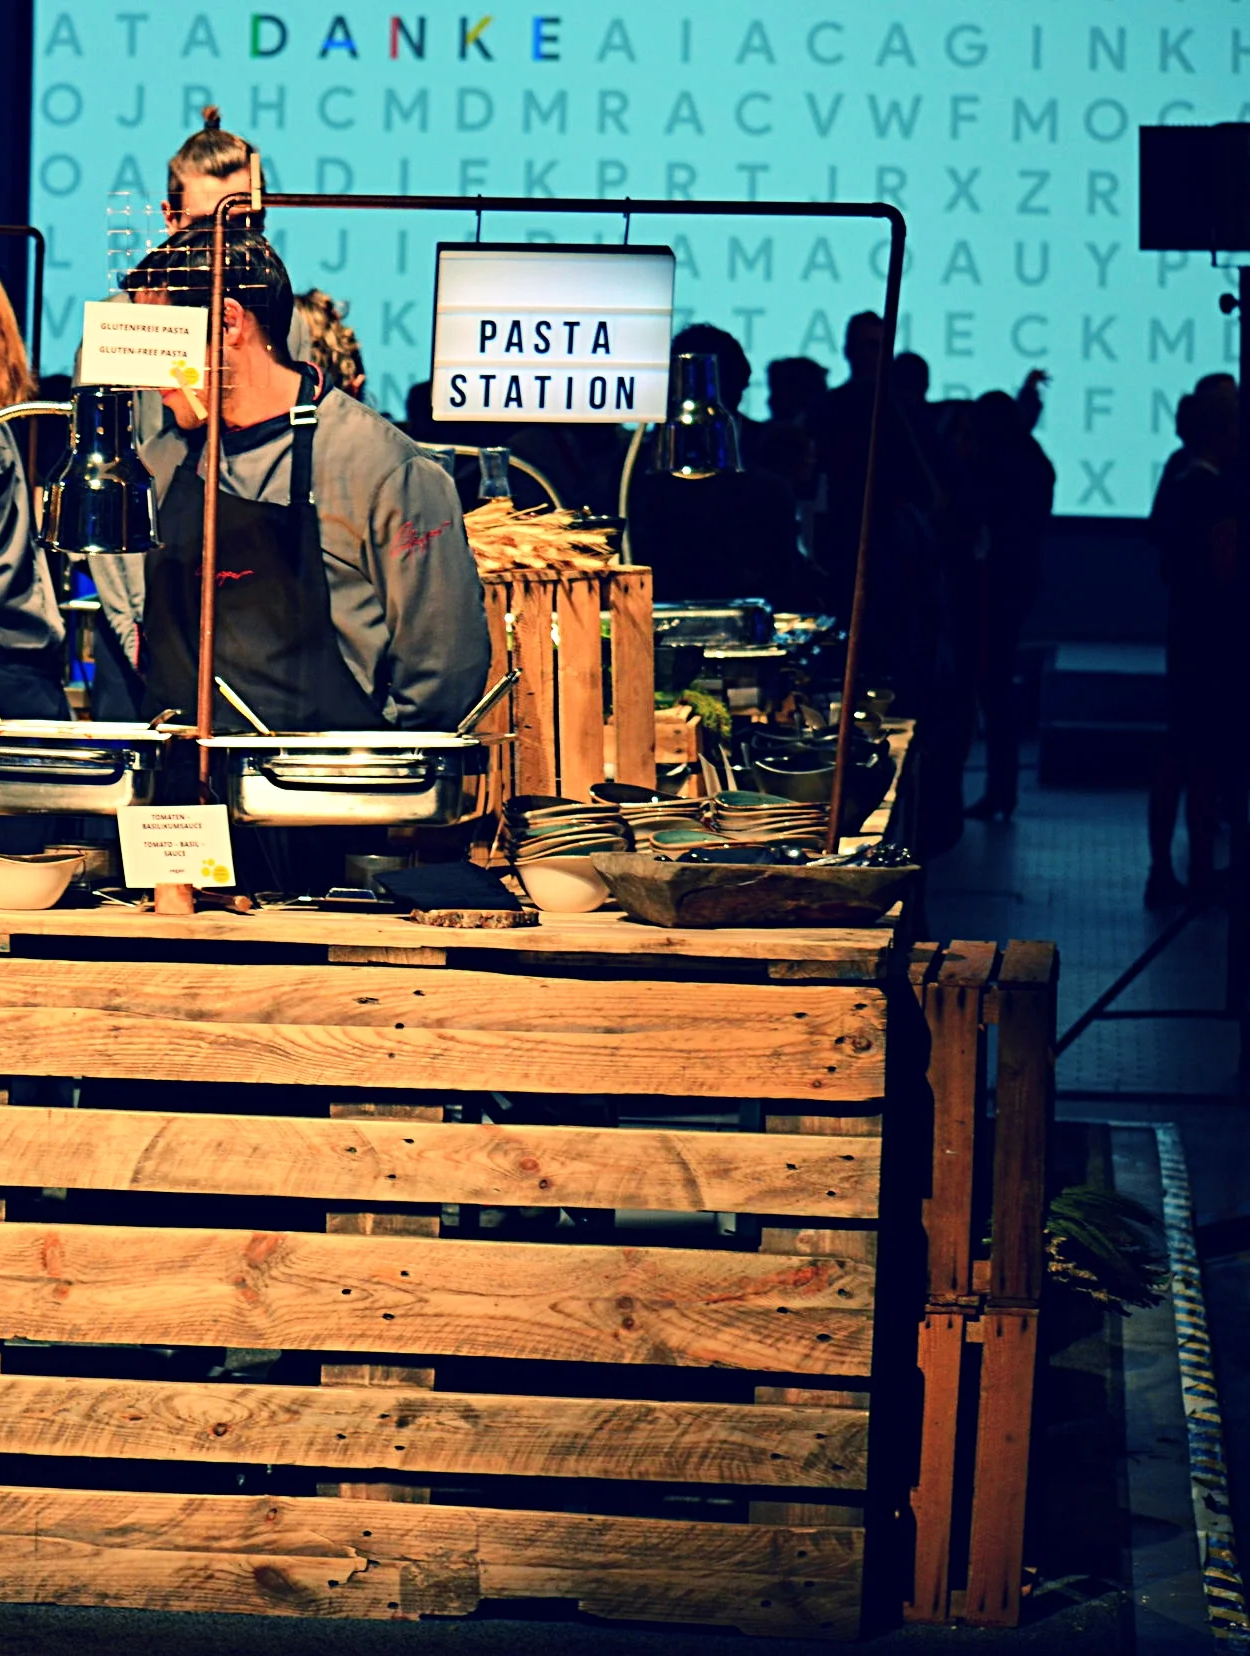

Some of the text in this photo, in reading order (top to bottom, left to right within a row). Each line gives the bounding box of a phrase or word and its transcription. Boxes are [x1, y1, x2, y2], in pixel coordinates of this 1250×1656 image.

[250, 14, 563, 62] DANKE
[100, 322, 190, 335] GLUTENFREIE PASTA
[479, 319, 611, 355] PASTA
[99, 346, 188, 358] GLUTEN-FREE PASTA
[449, 373, 635, 410] STATION
